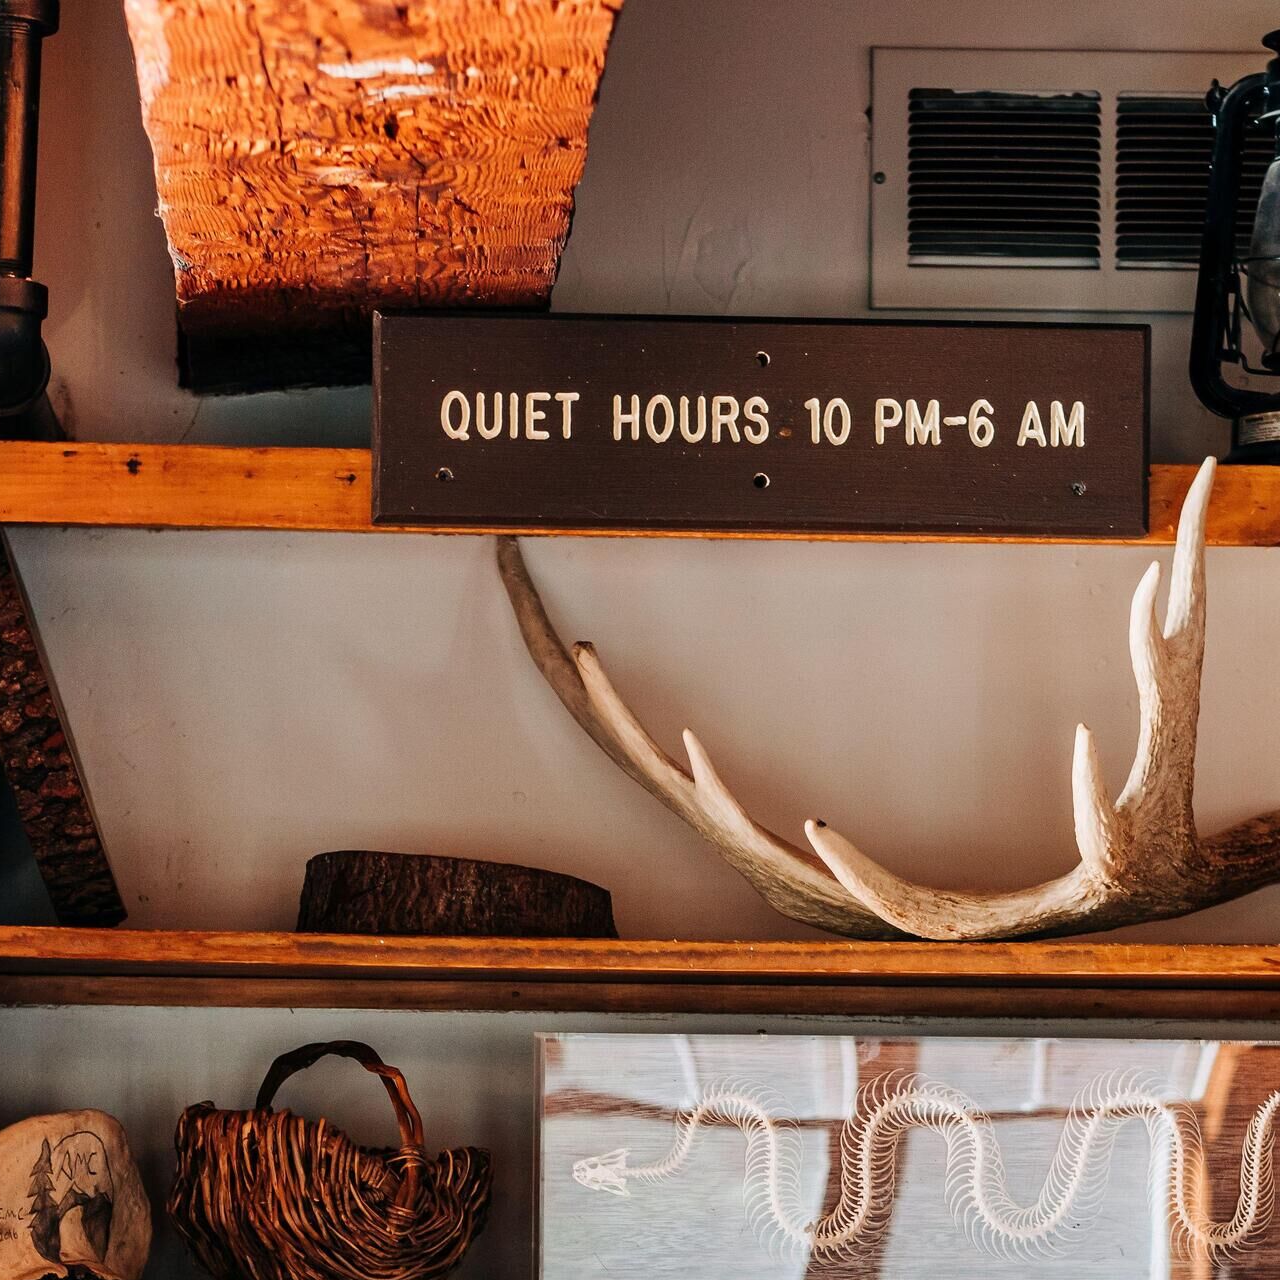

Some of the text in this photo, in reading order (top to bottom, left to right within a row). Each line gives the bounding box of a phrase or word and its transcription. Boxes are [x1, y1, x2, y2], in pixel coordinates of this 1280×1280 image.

[440, 390, 1086, 449] QUIET HOURS 10 PM-6 AM
